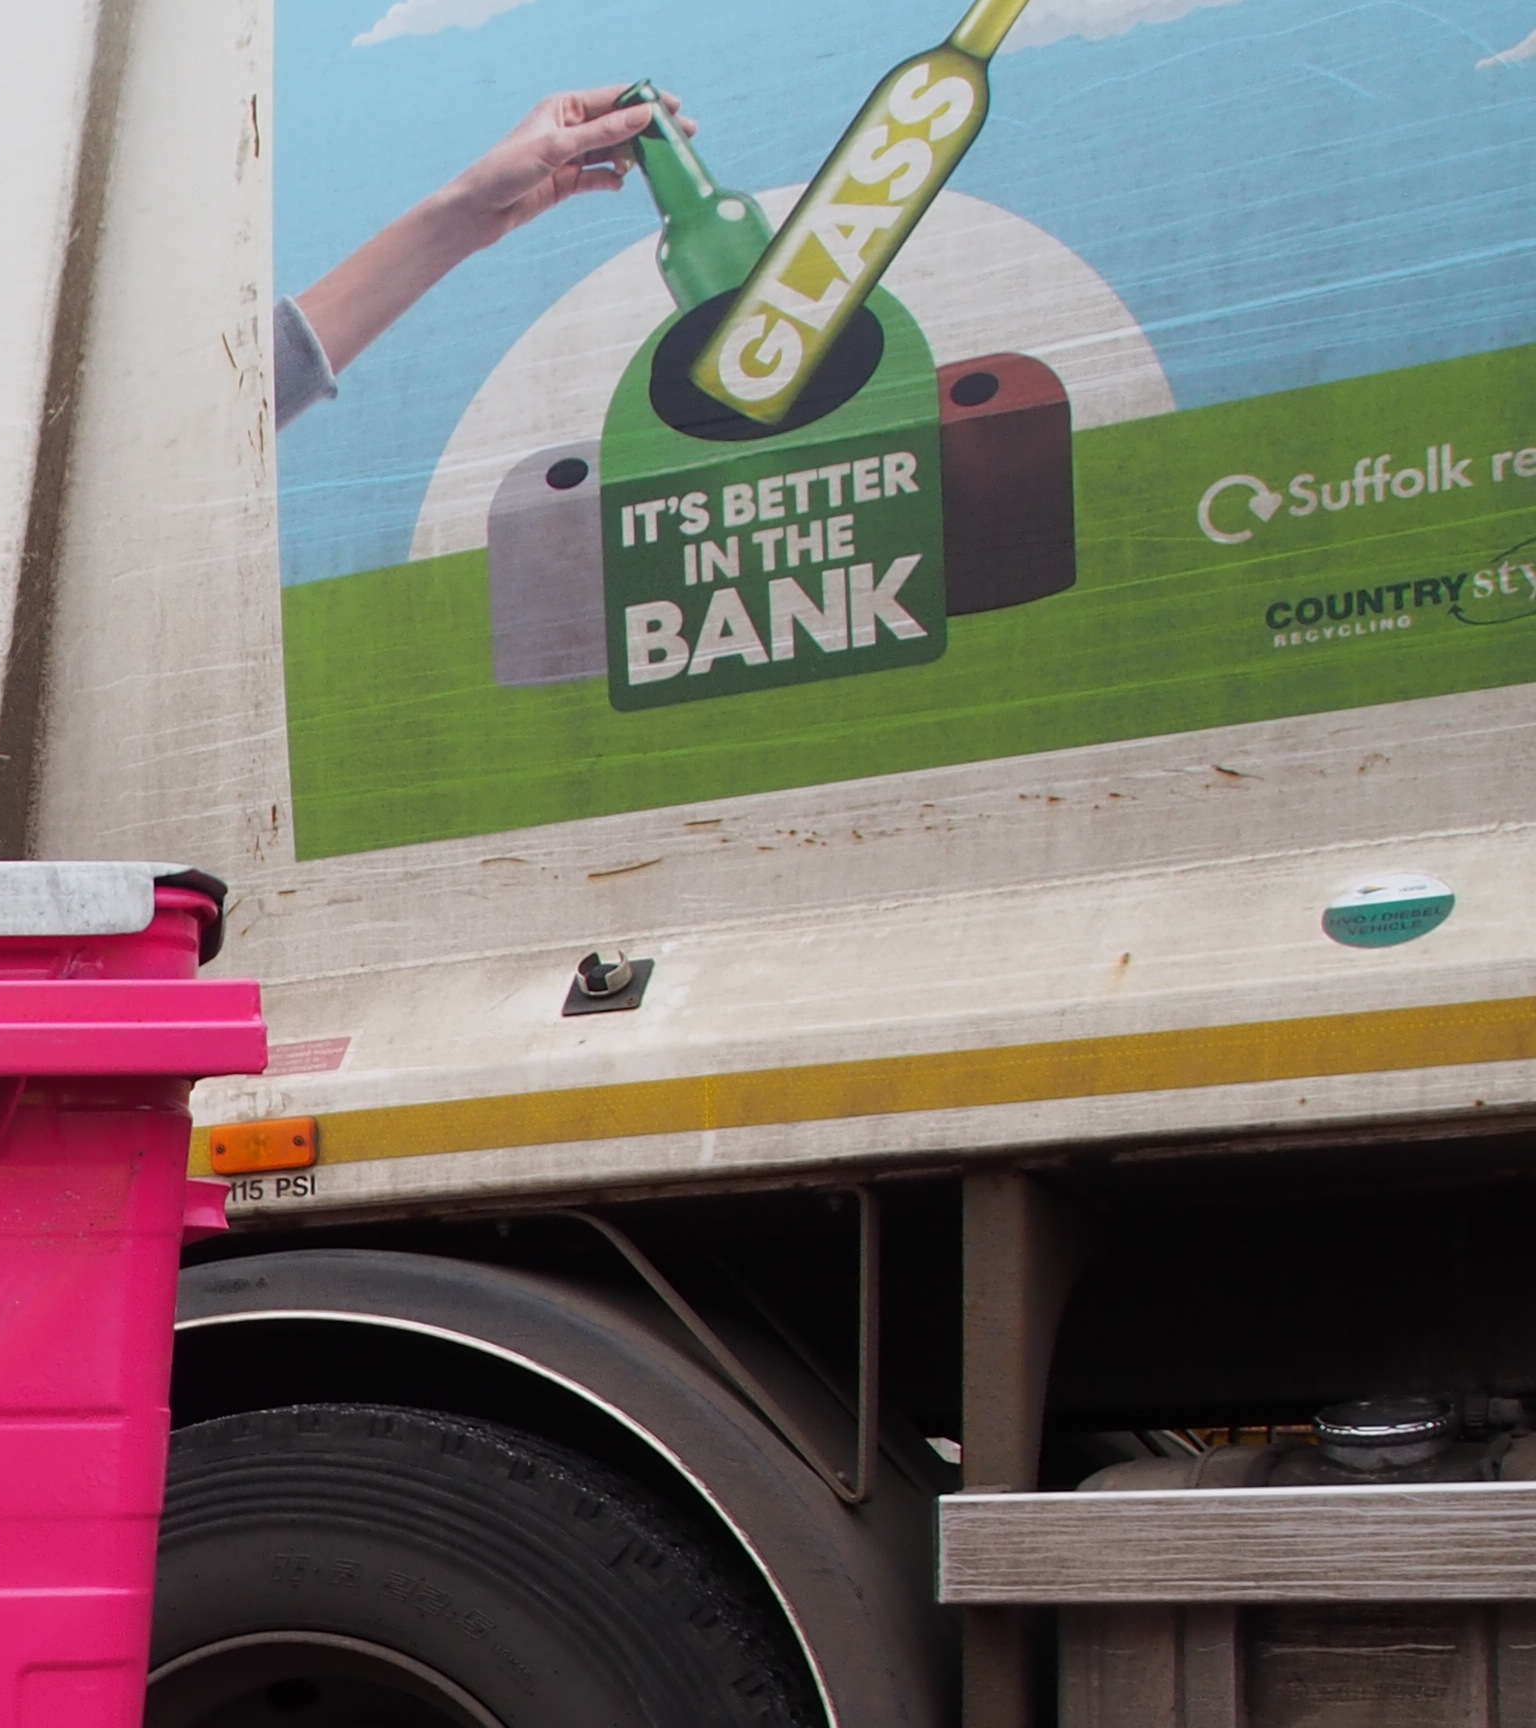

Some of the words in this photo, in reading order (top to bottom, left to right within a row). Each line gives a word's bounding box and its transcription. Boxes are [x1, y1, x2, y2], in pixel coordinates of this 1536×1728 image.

[718, 63, 975, 401] GLASS
[621, 491, 711, 547] IT'S
[723, 451, 919, 528] BETTER
[1288, 444, 1474, 517] Suffolk
[684, 535, 740, 585] IN
[753, 513, 855, 572] THE
[625, 553, 928, 687] BANK
[1274, 615, 1412, 649] RECYCLING
[1348, 920, 1423, 936] VEHICLE
[1381, 905, 1445, 921] DIESEL
[276, 1175, 316, 1198] PSI
